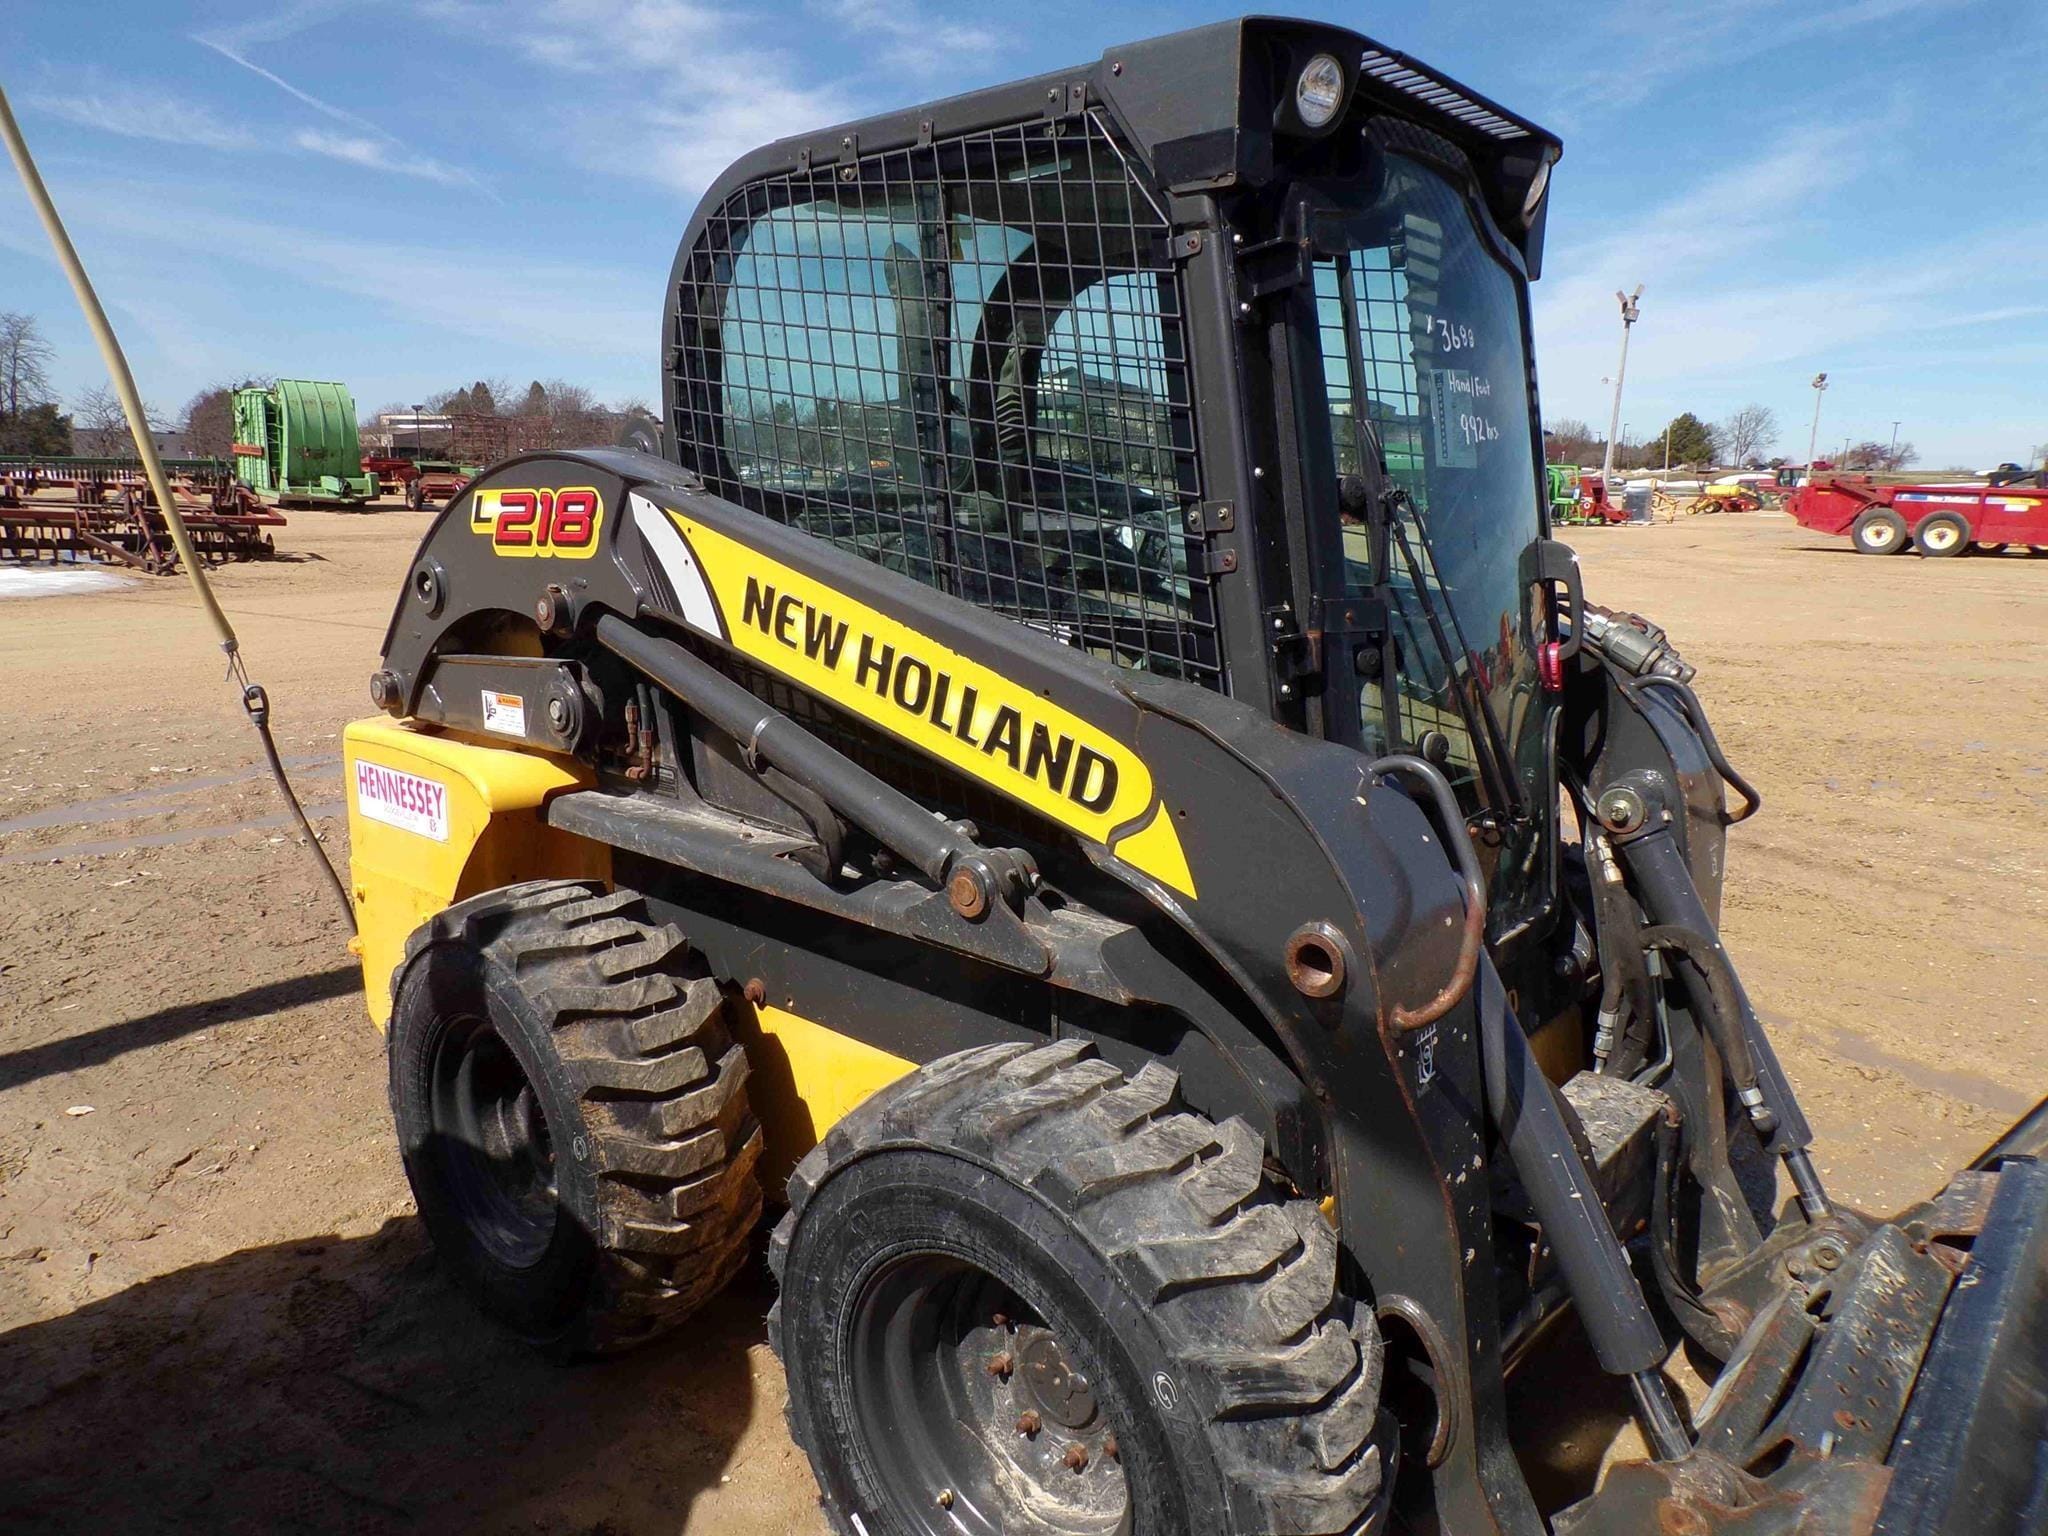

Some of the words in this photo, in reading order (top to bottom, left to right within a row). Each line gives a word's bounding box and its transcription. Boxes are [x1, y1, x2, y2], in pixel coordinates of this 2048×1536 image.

[472, 489, 602, 552] L218
[742, 575, 849, 671] NEW
[855, 632, 1119, 815] HOLLAND
[357, 763, 443, 820] HENNESSEY
